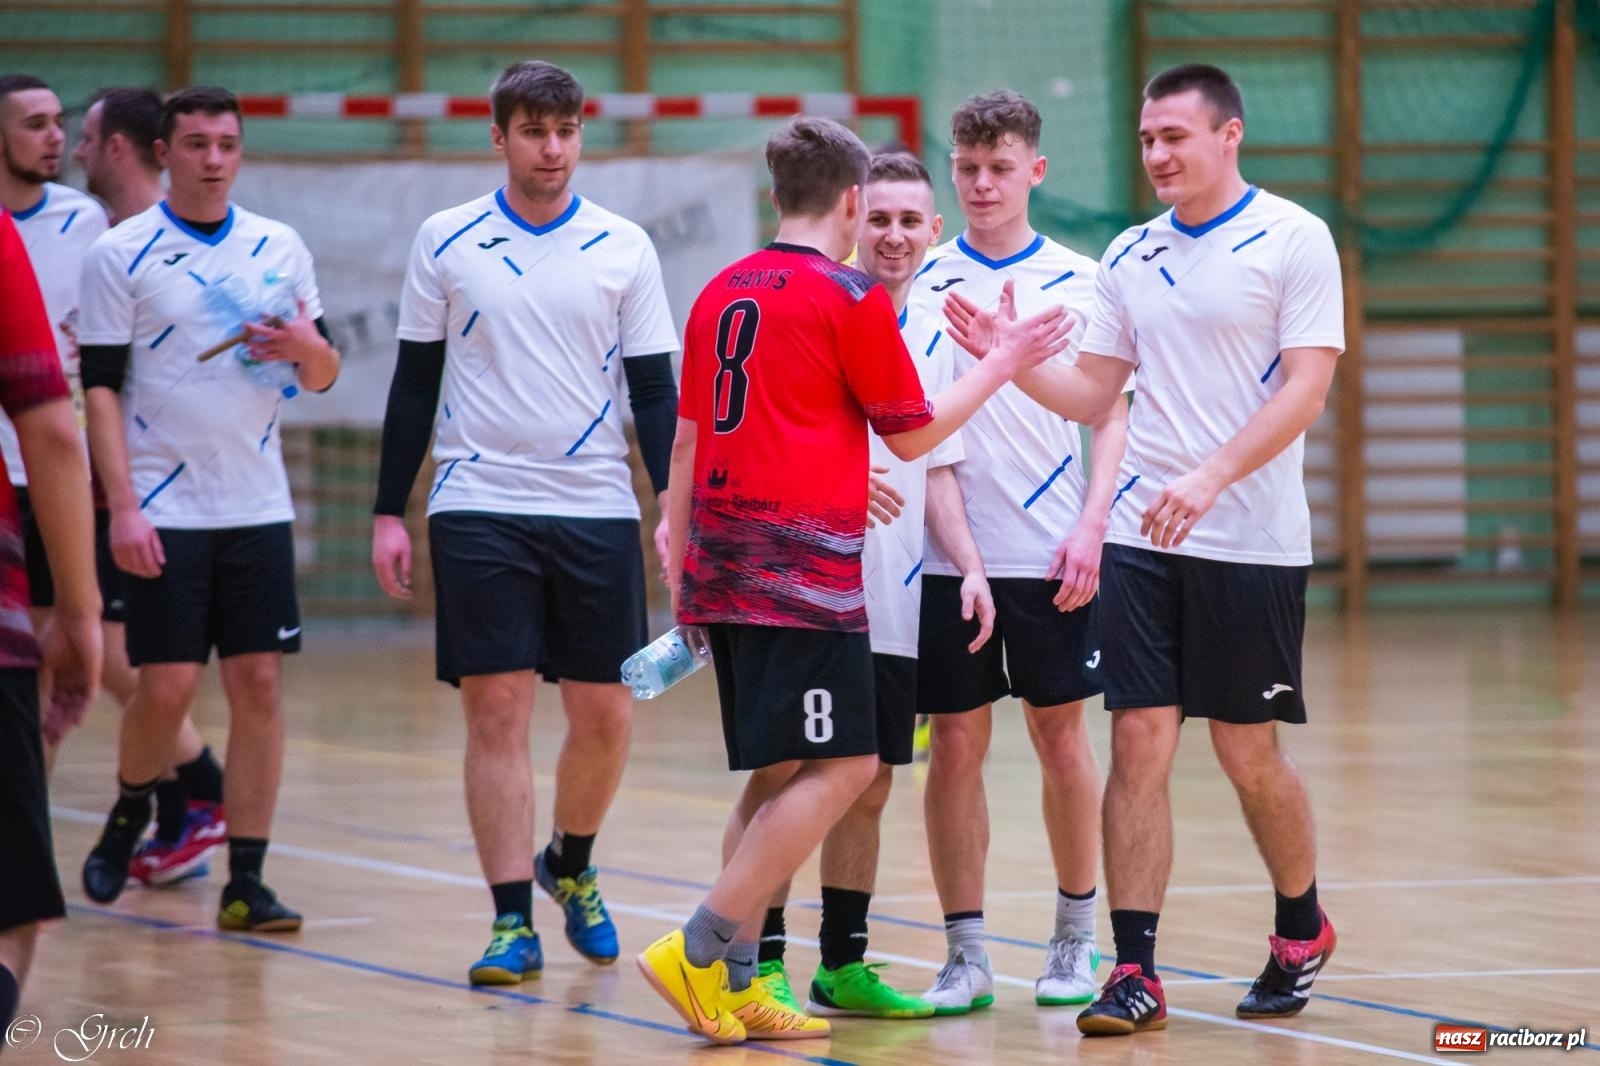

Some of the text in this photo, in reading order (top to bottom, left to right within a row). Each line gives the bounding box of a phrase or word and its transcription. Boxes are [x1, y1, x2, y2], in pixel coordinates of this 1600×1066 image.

[726, 270, 792, 290] HANYS
[713, 297, 761, 435] 8
[803, 688, 834, 743] 8
